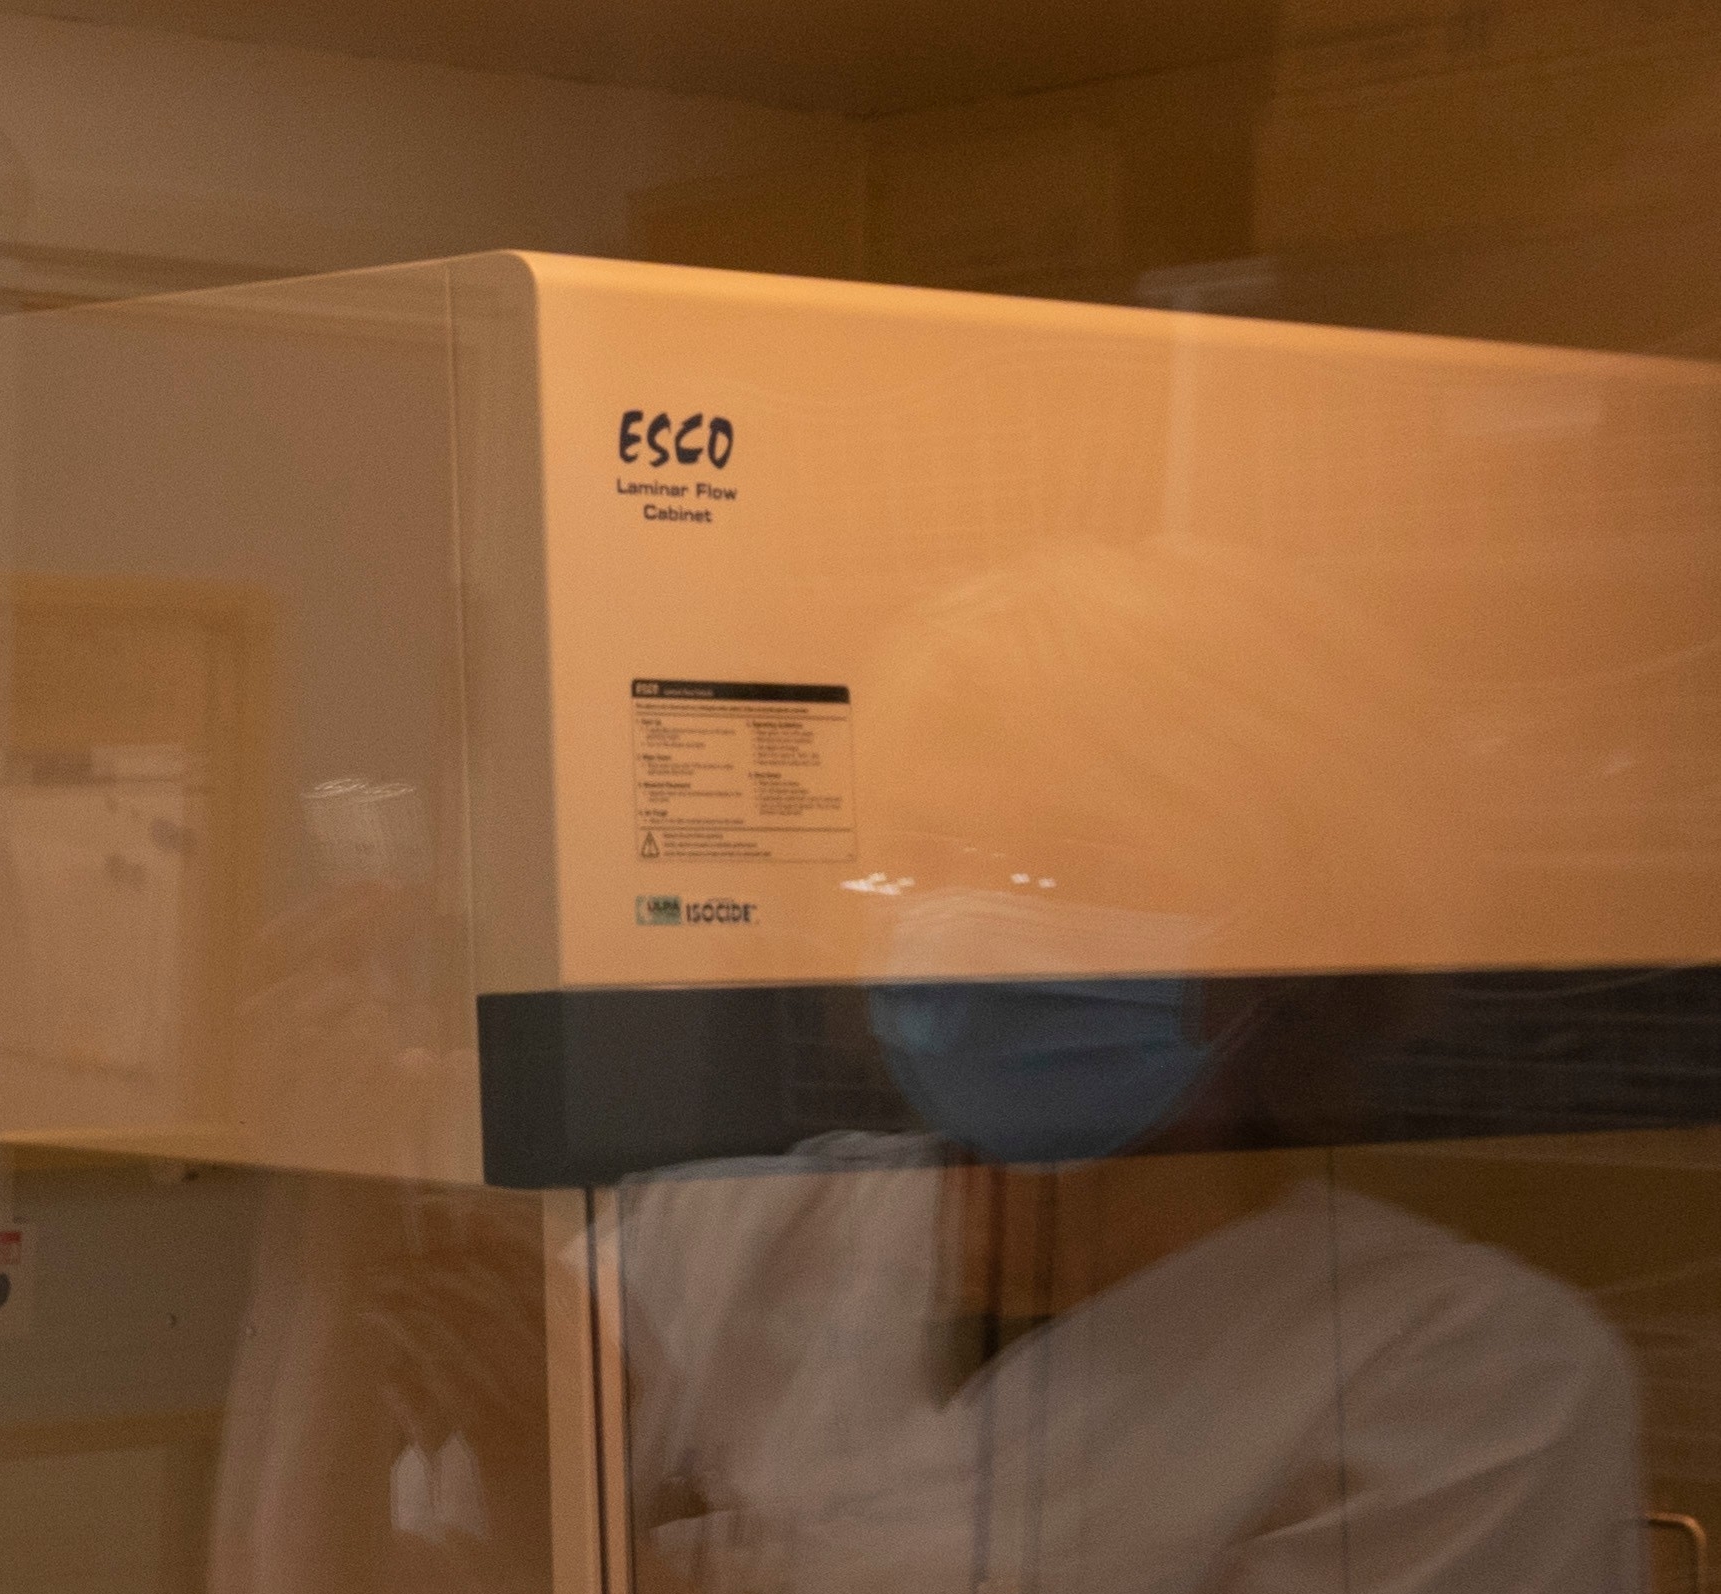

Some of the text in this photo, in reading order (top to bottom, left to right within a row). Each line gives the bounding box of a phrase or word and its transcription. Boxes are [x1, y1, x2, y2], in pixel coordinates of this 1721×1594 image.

[619, 410, 734, 469] ESCO
[616, 479, 737, 500] Laminar Flow
[643, 503, 713, 523] Cabinet
[685, 902, 752, 924] ISOCIDE
